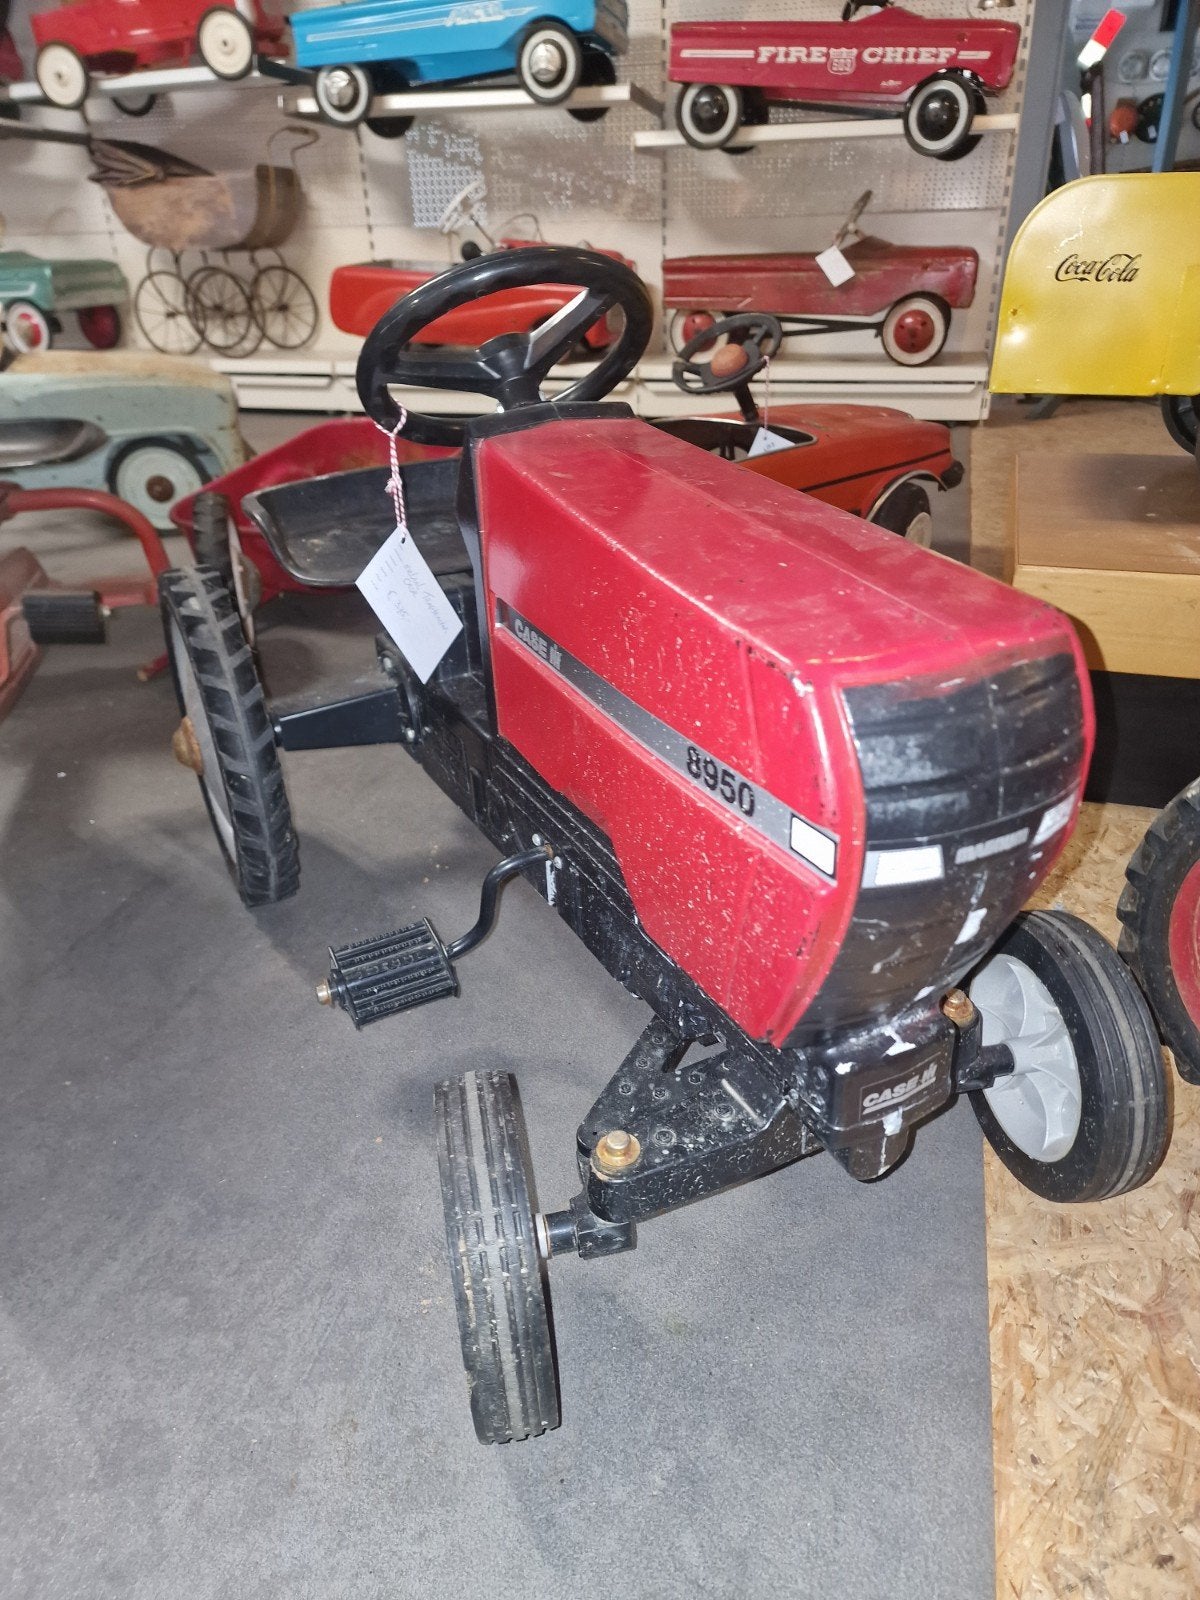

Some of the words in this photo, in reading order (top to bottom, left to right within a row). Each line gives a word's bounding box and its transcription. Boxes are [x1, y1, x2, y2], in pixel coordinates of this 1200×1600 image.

[757, 46, 827, 64] FIRE
[861, 47, 956, 64] CHIEF
[514, 618, 548, 659] CASE
[686, 746, 755, 817] 8950
[862, 1074, 920, 1108] CASE
